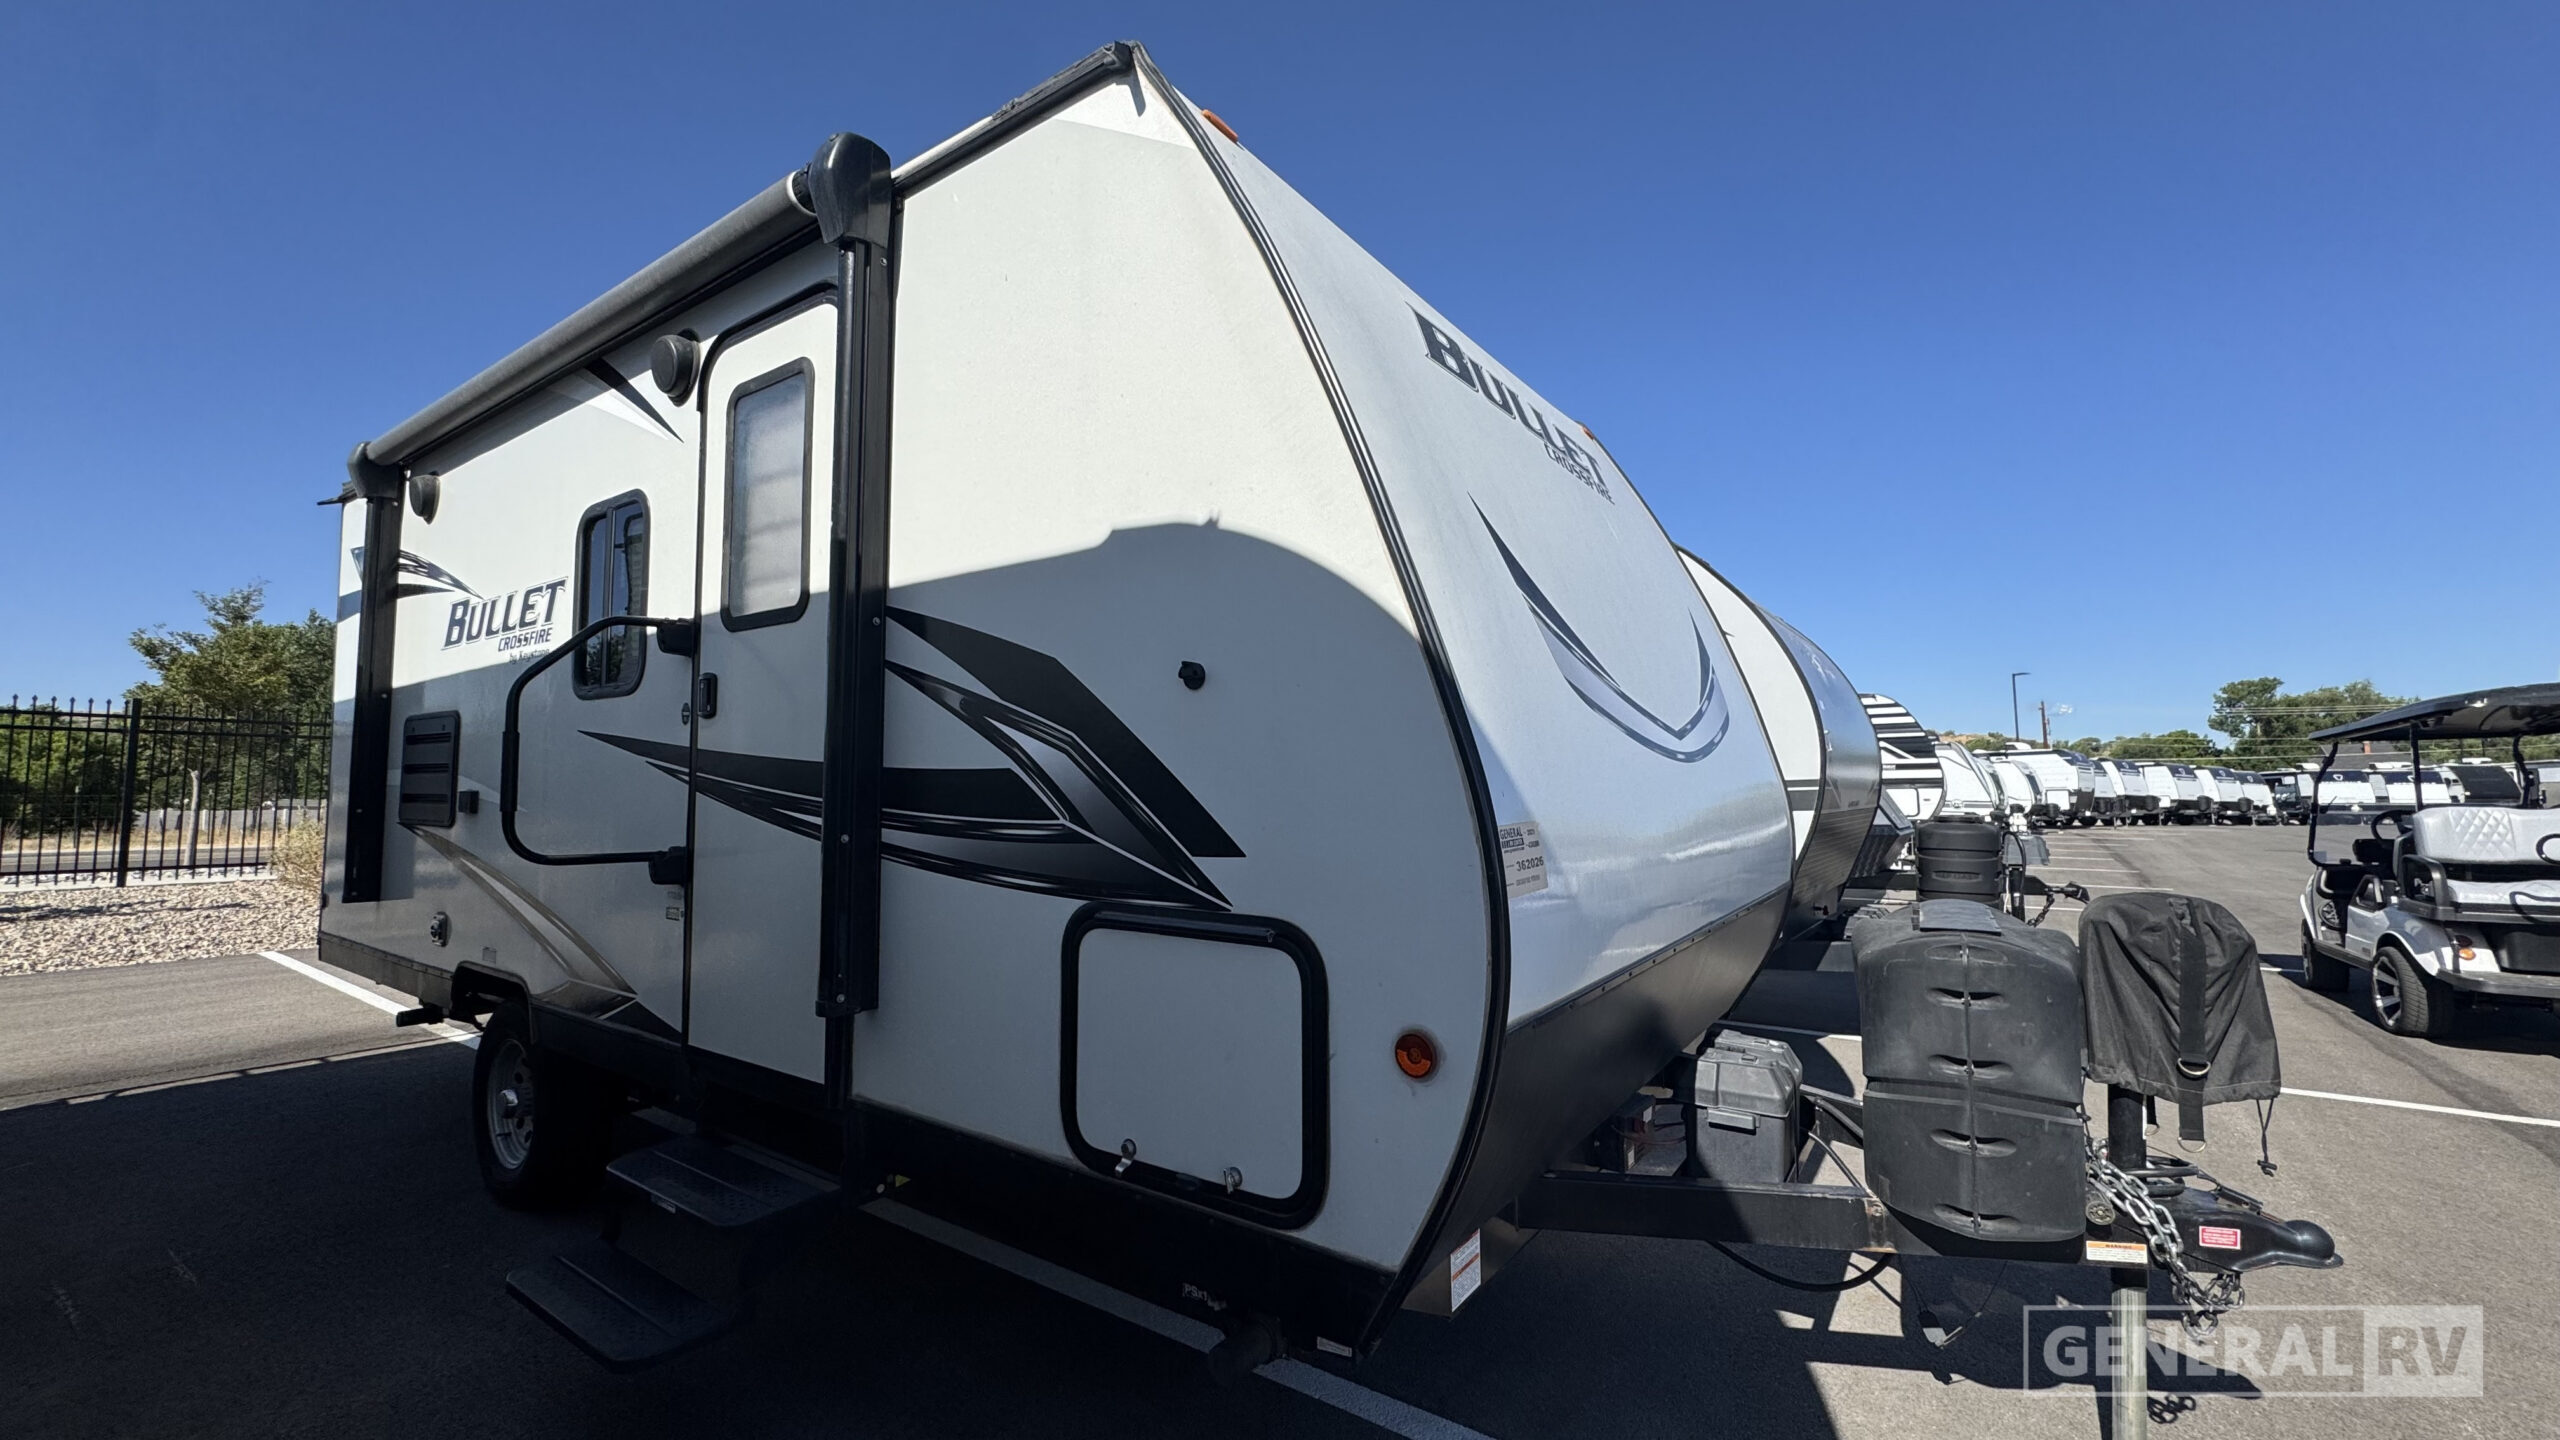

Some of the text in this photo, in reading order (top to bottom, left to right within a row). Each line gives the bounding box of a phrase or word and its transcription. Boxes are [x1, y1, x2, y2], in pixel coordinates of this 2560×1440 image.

[1404, 301, 1607, 488] BULLET
[441, 576, 568, 650] BULLET
[497, 627, 553, 652] CROSSFIRE
[1500, 827, 1523, 840] GENERAL
